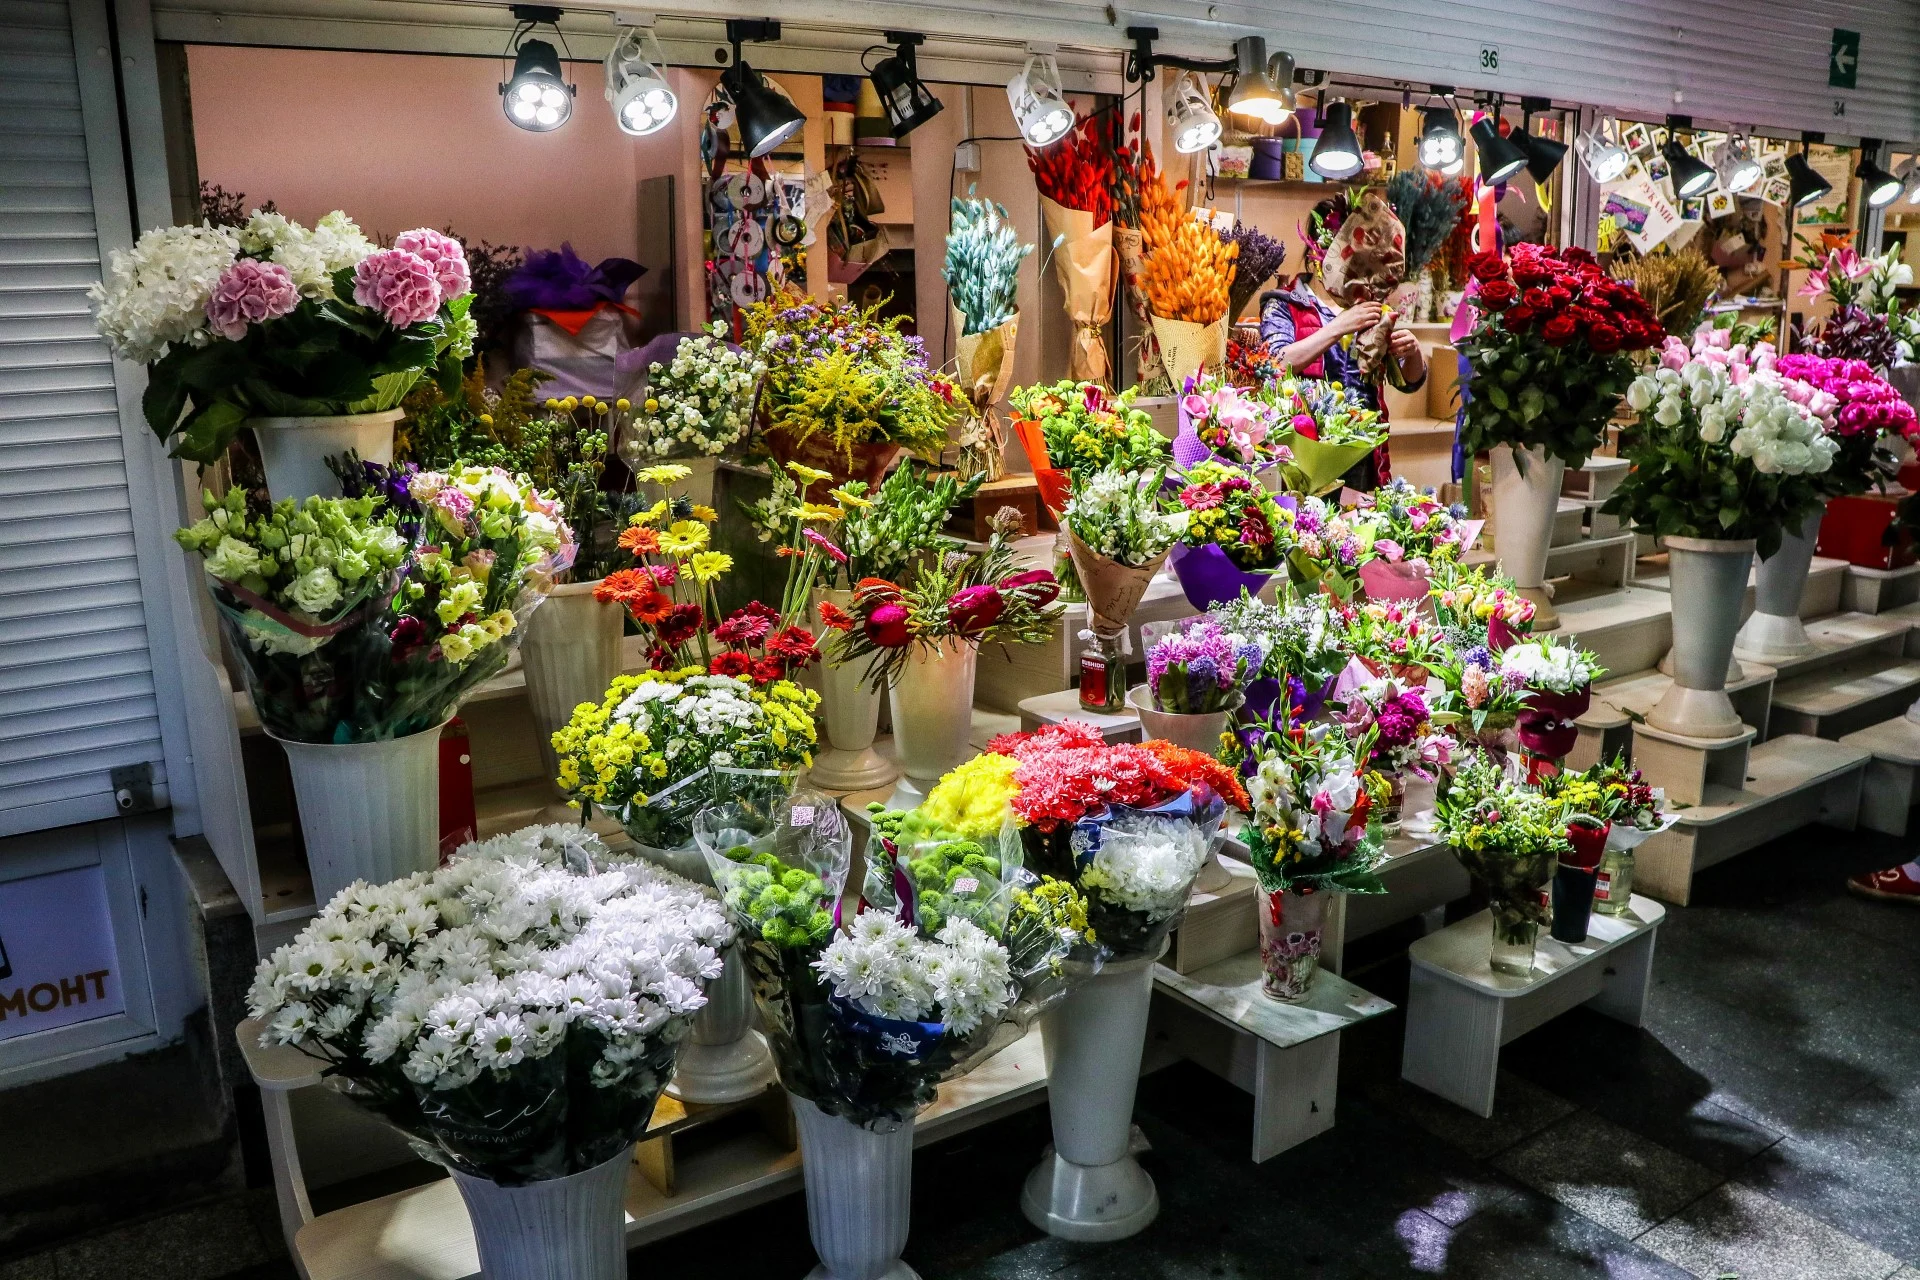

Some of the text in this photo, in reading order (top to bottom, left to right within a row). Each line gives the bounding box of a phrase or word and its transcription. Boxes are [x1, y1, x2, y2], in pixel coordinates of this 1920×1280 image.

[1481, 49, 1498, 69] 36
[1833, 100, 1845, 117] 34
[1639, 180, 1675, 224] РУКАМИ
[1081, 659, 1105, 669] BUSHIDO
[0, 969, 110, 1021] МОНТ
